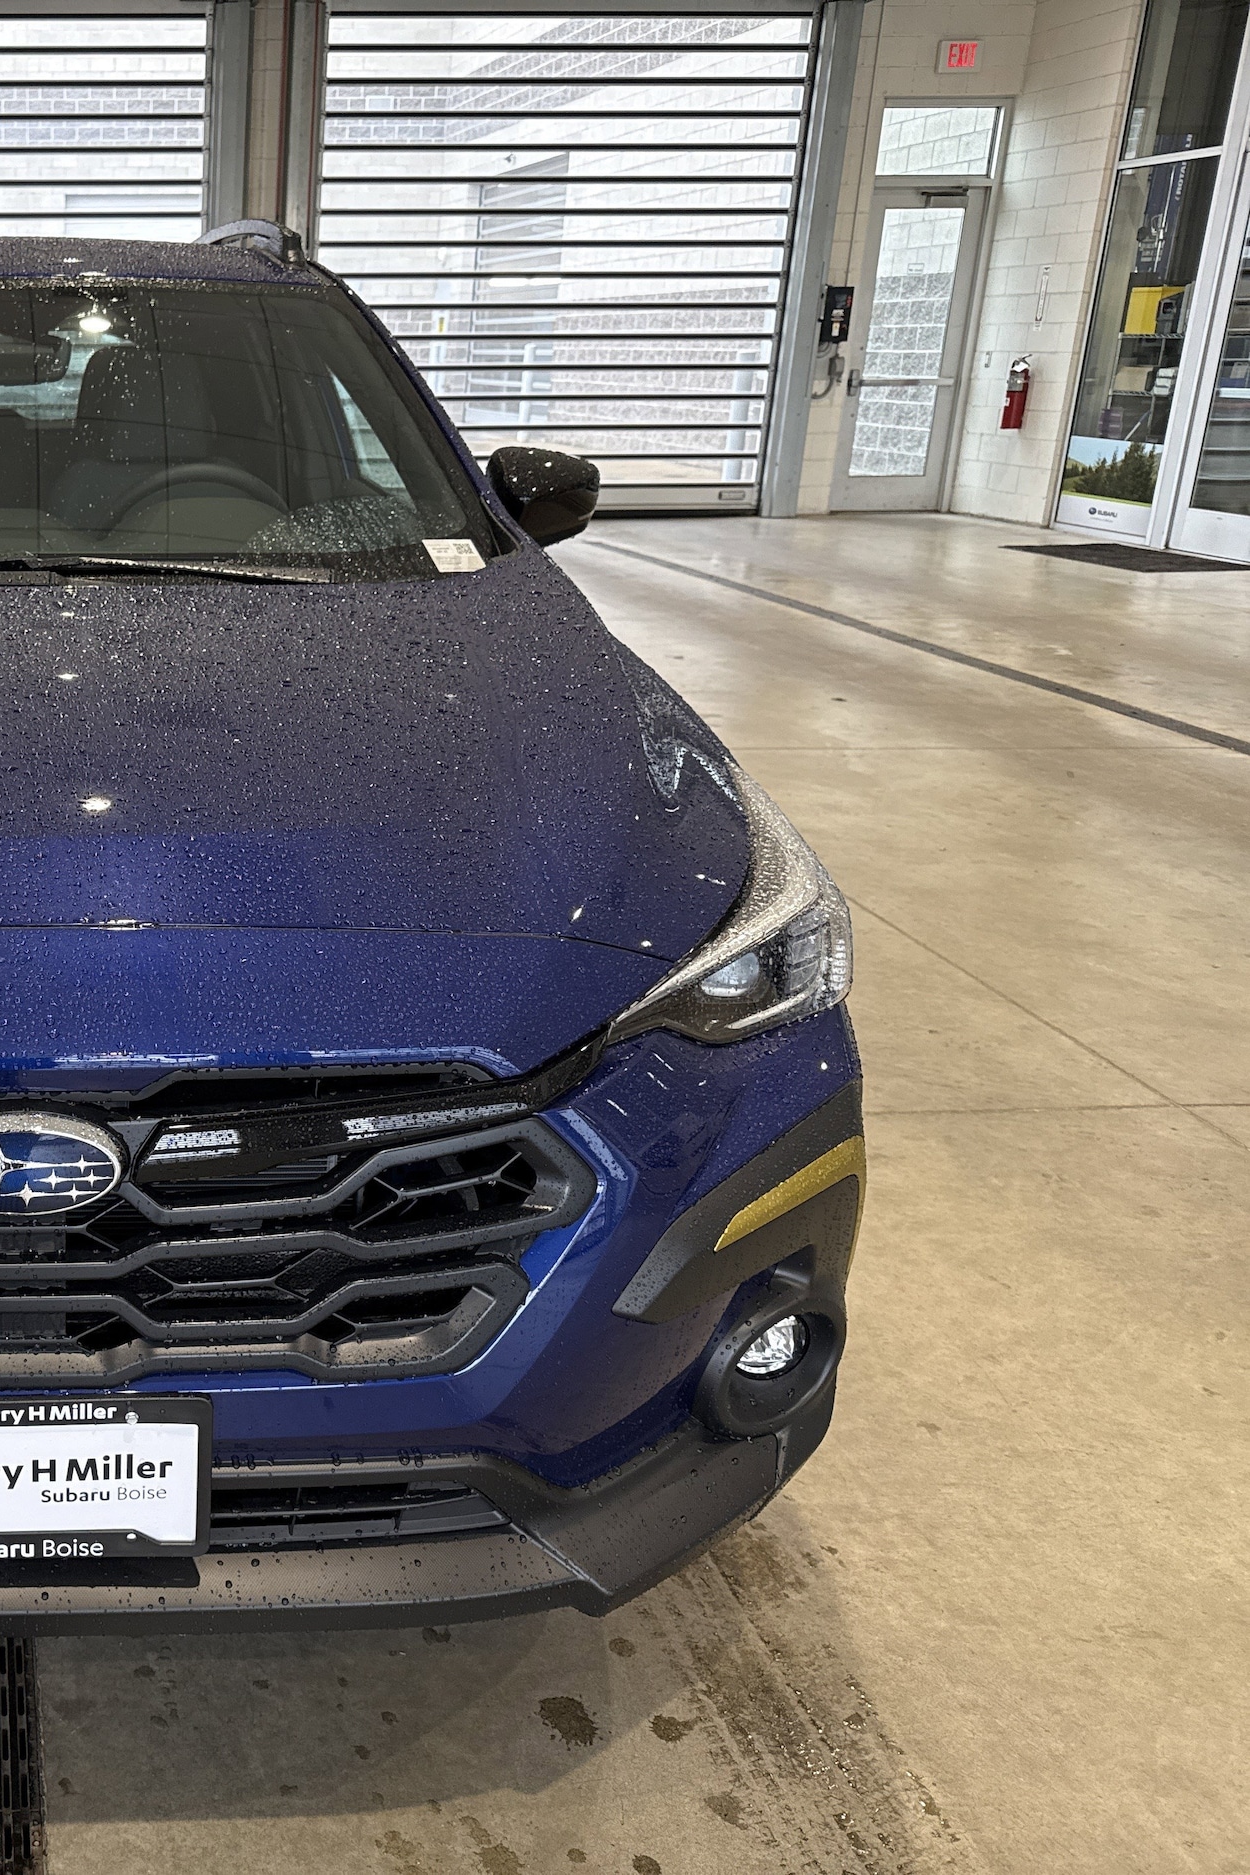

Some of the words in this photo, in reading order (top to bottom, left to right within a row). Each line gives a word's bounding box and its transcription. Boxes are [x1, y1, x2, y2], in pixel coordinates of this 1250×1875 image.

[947, 42, 978, 67] EXIT
[28, 1406, 45, 1421] H
[49, 1403, 117, 1420] Miller
[32, 1459, 56, 1482] H
[66, 1454, 173, 1481] Miller
[41, 1487, 110, 1503] Subaru
[117, 1486, 167, 1500] Boise
[42, 1538, 104, 1557] Boise
